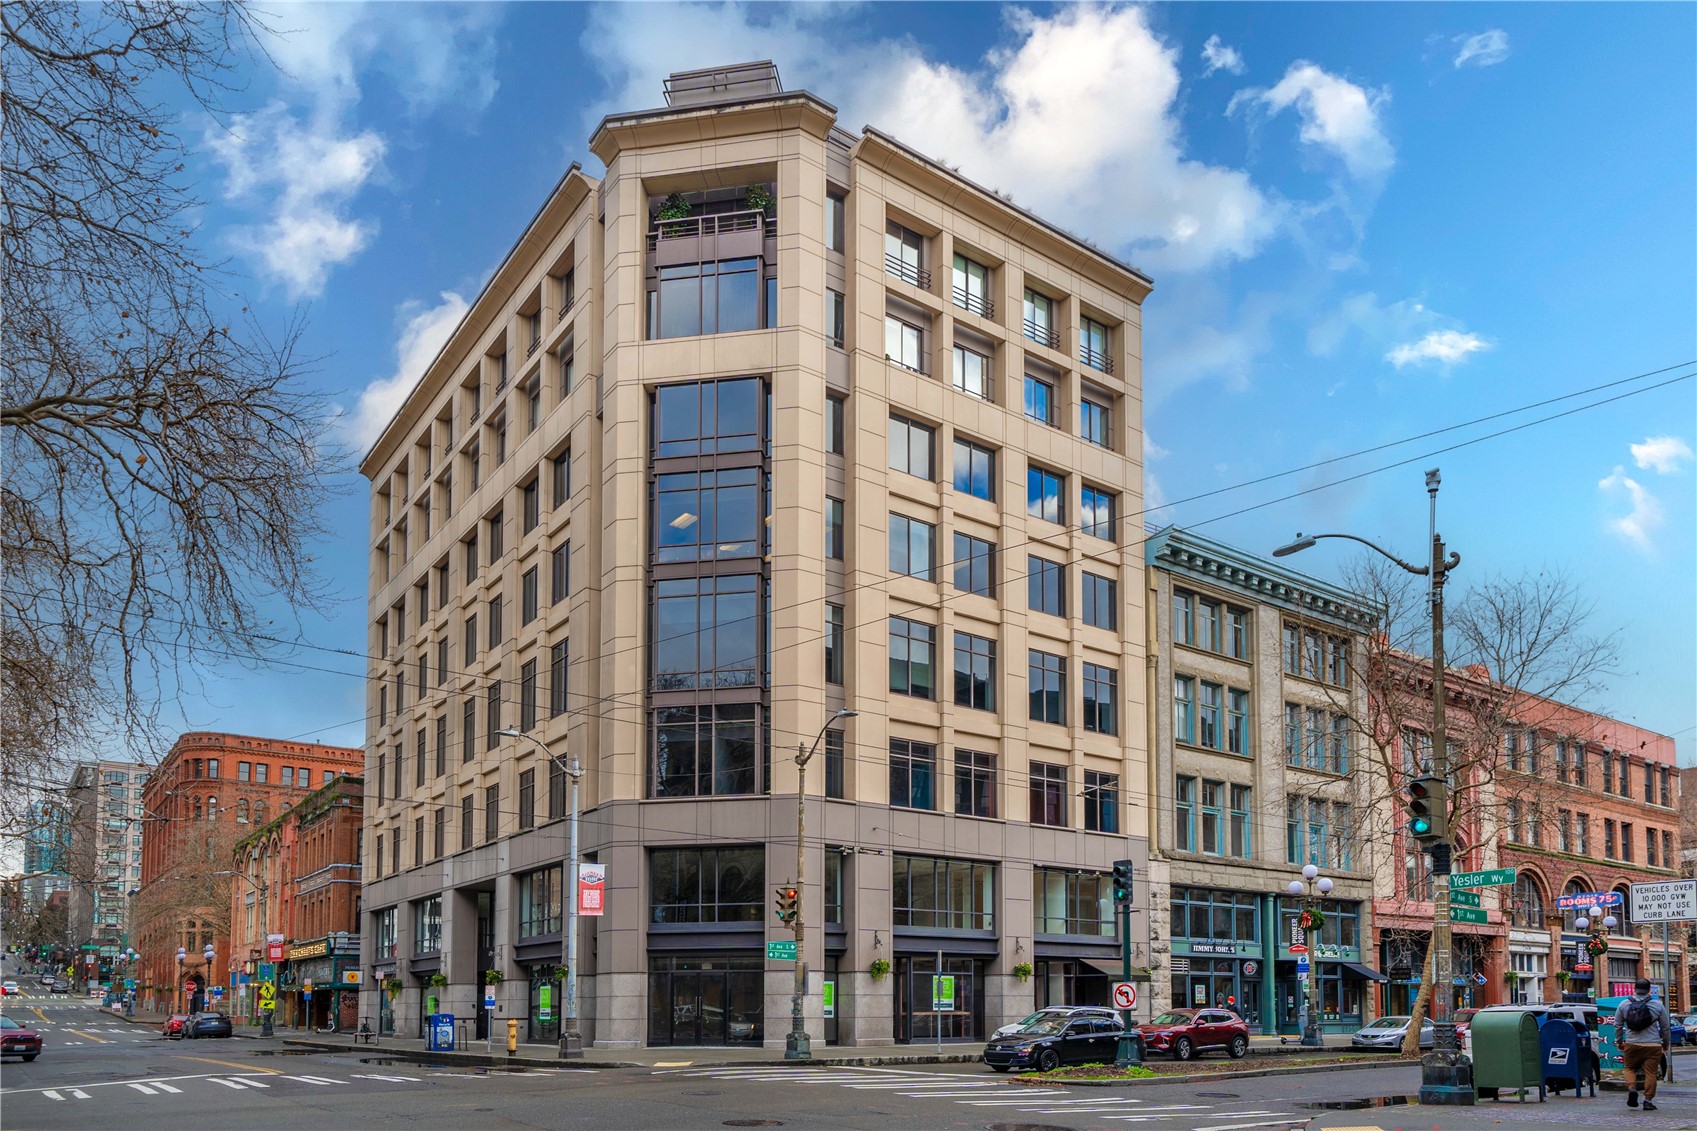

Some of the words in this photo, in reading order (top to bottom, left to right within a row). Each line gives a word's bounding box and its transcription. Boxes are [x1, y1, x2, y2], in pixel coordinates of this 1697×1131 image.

[1452, 874, 1485, 887] Yesler
[1491, 874, 1504, 884] Wy
[1635, 885, 1670, 894] VEHICLES
[1673, 884, 1694, 892] OVER
[1457, 894, 1466, 902] Ave
[1469, 895, 1472, 903] S
[1560, 897, 1597, 907] ROOMS
[1466, 912, 1476, 920] Ave
[1643, 911, 1663, 919] CURB
